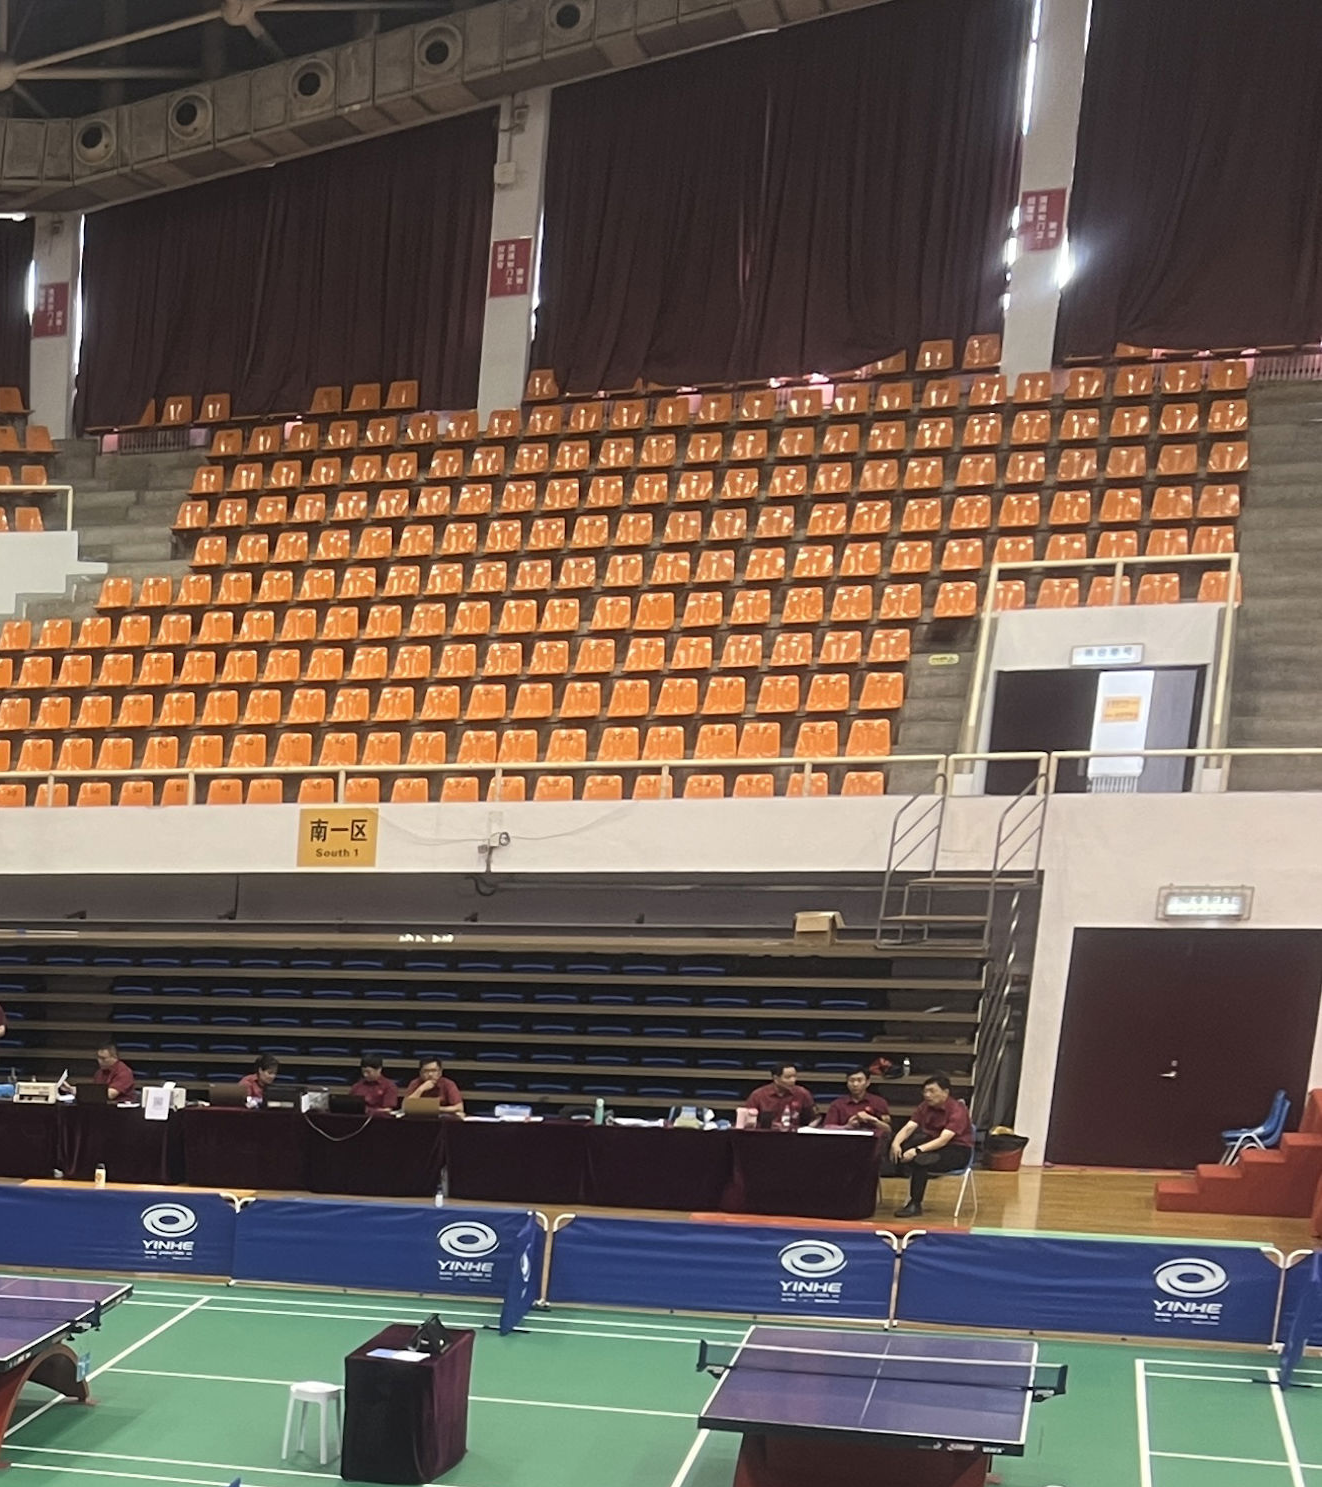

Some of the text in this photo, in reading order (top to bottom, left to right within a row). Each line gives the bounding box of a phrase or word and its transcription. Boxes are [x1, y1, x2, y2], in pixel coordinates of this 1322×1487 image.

[310, 818, 368, 842] 南一区
[315, 848, 359, 857] South 1
[142, 1239, 195, 1251] YINHE
[437, 1260, 494, 1273] YINHE
[779, 1281, 843, 1293] YINHE
[1153, 1300, 1223, 1315] YINHE
